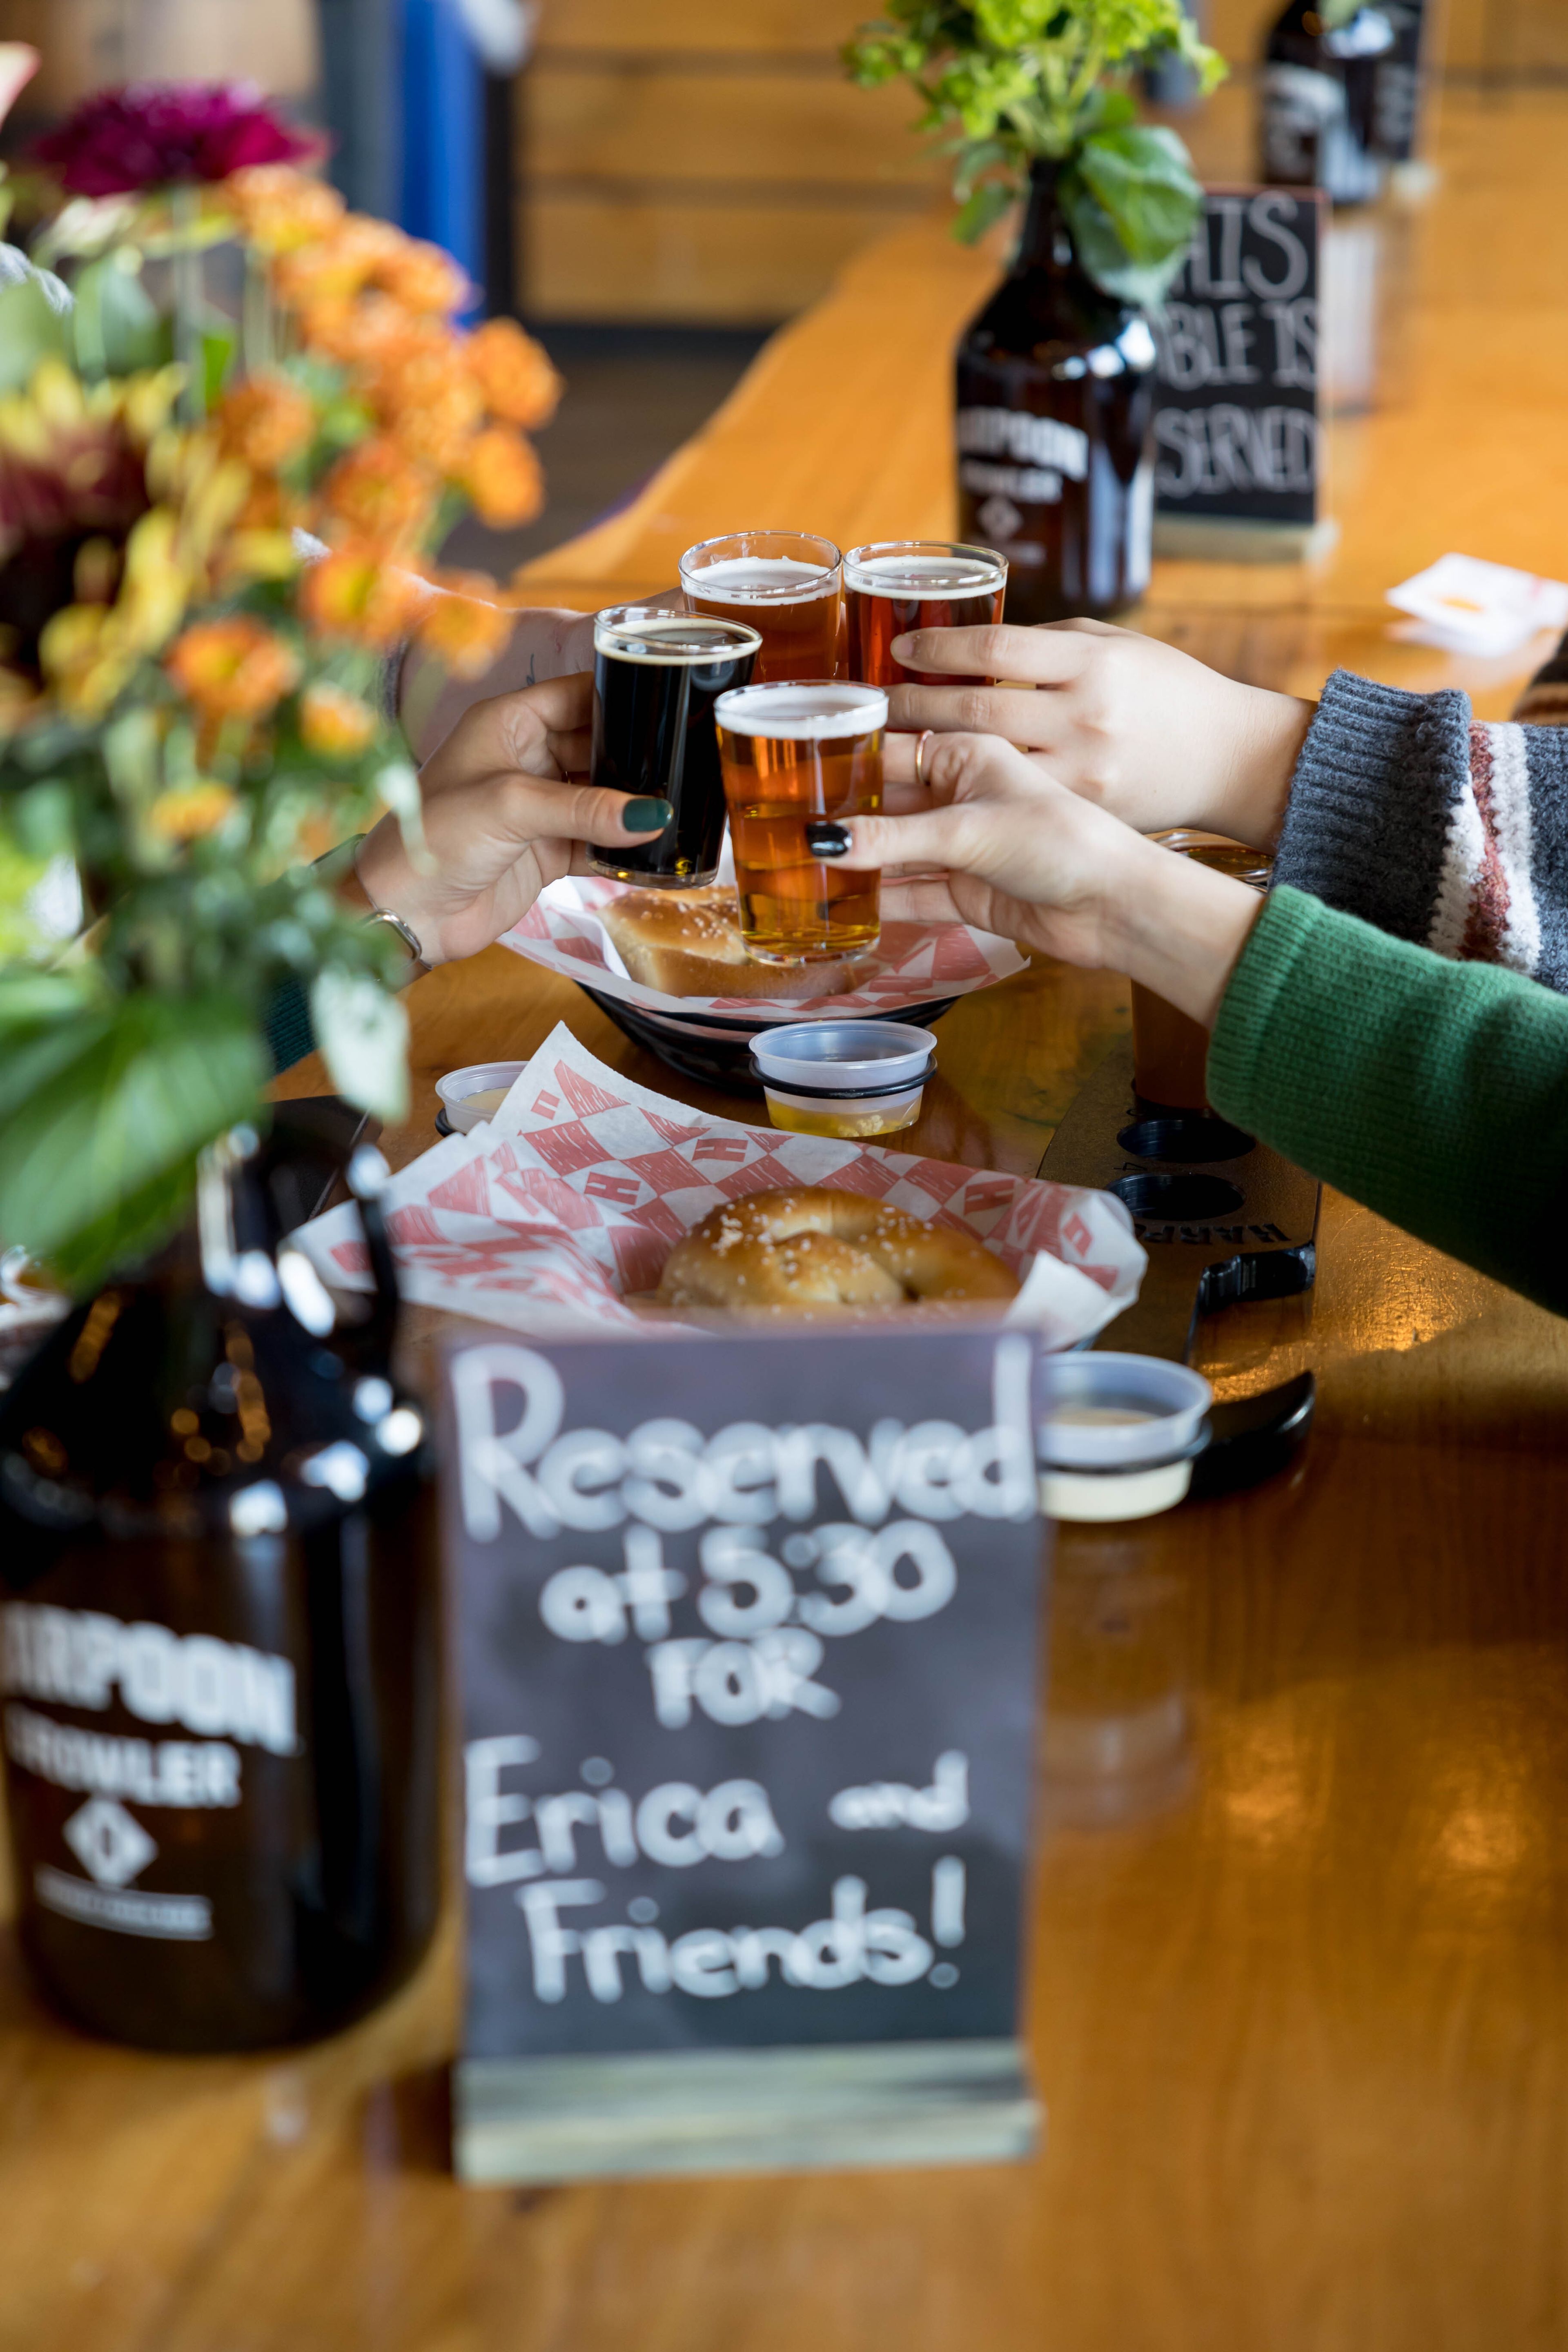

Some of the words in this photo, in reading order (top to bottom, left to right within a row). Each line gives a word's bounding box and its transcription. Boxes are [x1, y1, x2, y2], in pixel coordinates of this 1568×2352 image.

[1170, 190, 1310, 301] HIS
[1155, 298, 1263, 392] BLE
[1153, 402, 1320, 499] SERVED
[452, 1335, 1038, 1542] Reserved
[539, 1524, 687, 1646] at
[697, 1519, 957, 1638] 5:30
[465, 1735, 785, 1886] Erica
[829, 1749, 970, 1832] and
[515, 1855, 966, 2003] Friends!
